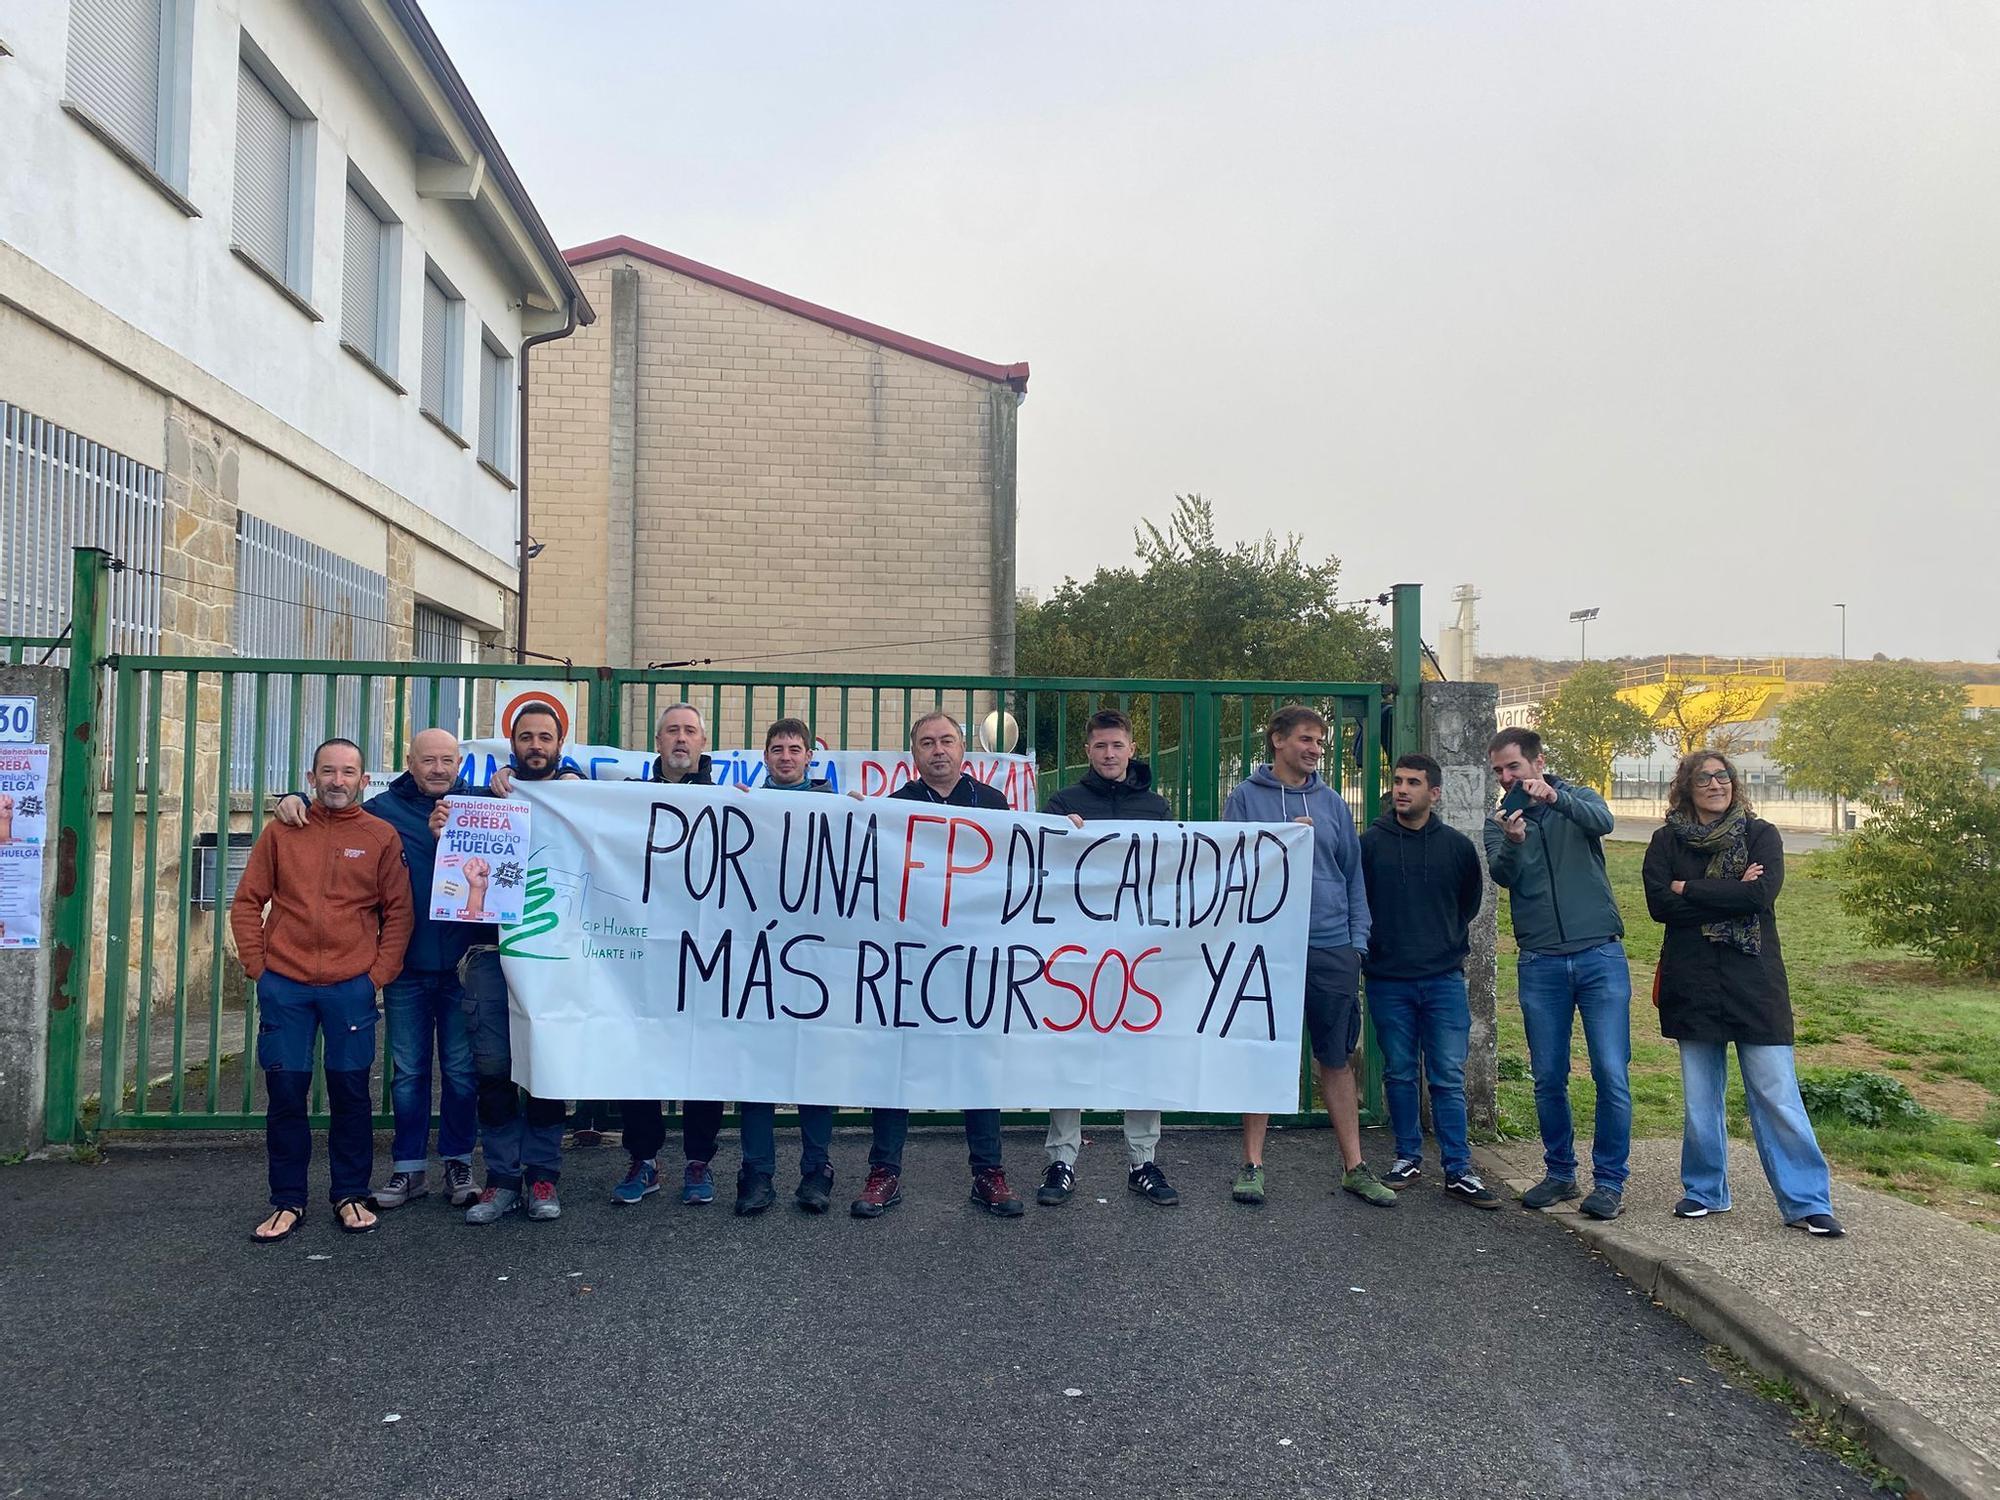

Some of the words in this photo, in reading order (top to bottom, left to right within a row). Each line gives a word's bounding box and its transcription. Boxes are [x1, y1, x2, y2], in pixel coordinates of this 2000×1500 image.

[457, 815, 511, 830] GREBA
[445, 829, 521, 844] #FPenlucha
[450, 839, 515, 855] HUELGA
[642, 801, 758, 912] POR
[779, 811, 880, 922] UNA
[898, 814, 994, 928] FP
[1000, 823, 1069, 925] DE
[677, 919, 829, 1020] MÁS
[855, 939, 1162, 1034] RECURSOS
[1196, 941, 1276, 1041] YA
